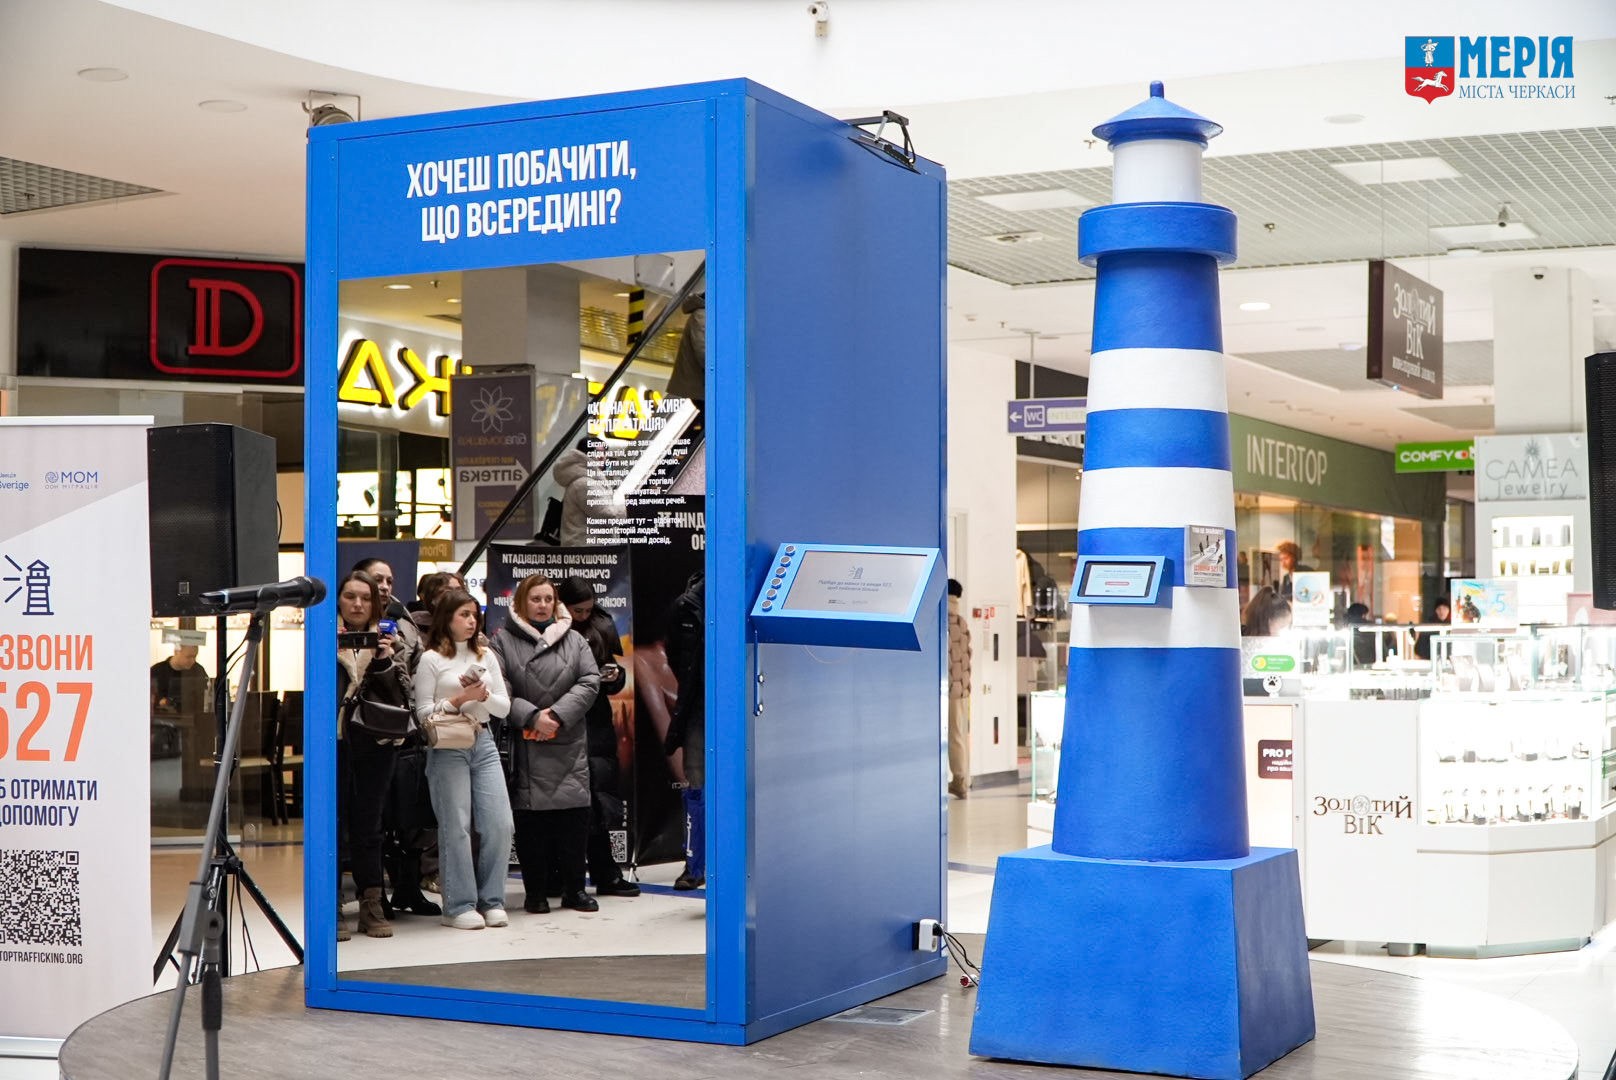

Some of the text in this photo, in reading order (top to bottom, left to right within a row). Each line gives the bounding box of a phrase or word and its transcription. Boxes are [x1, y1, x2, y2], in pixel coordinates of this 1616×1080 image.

[406, 140, 637, 198] ХОЧЕШ ПОБАЧИТИ,
[421, 188, 622, 243] ЩО ВСЕРЕДИНІ?
[1026, 410, 1043, 422] WC
[1246, 433, 1328, 487] INTERTOP
[1399, 449, 1454, 463] COMFY
[61, 471, 98, 483] МОМ
[1485, 458, 1578, 481] CAMEA
[0, 634, 93, 670] ЗВОНИ
[0, 681, 93, 762] 27
[1262, 748, 1284, 758] PRO
[11, 779, 97, 801] ОТРИМАТИ
[0, 804, 79, 827] ОПОМОГУ
